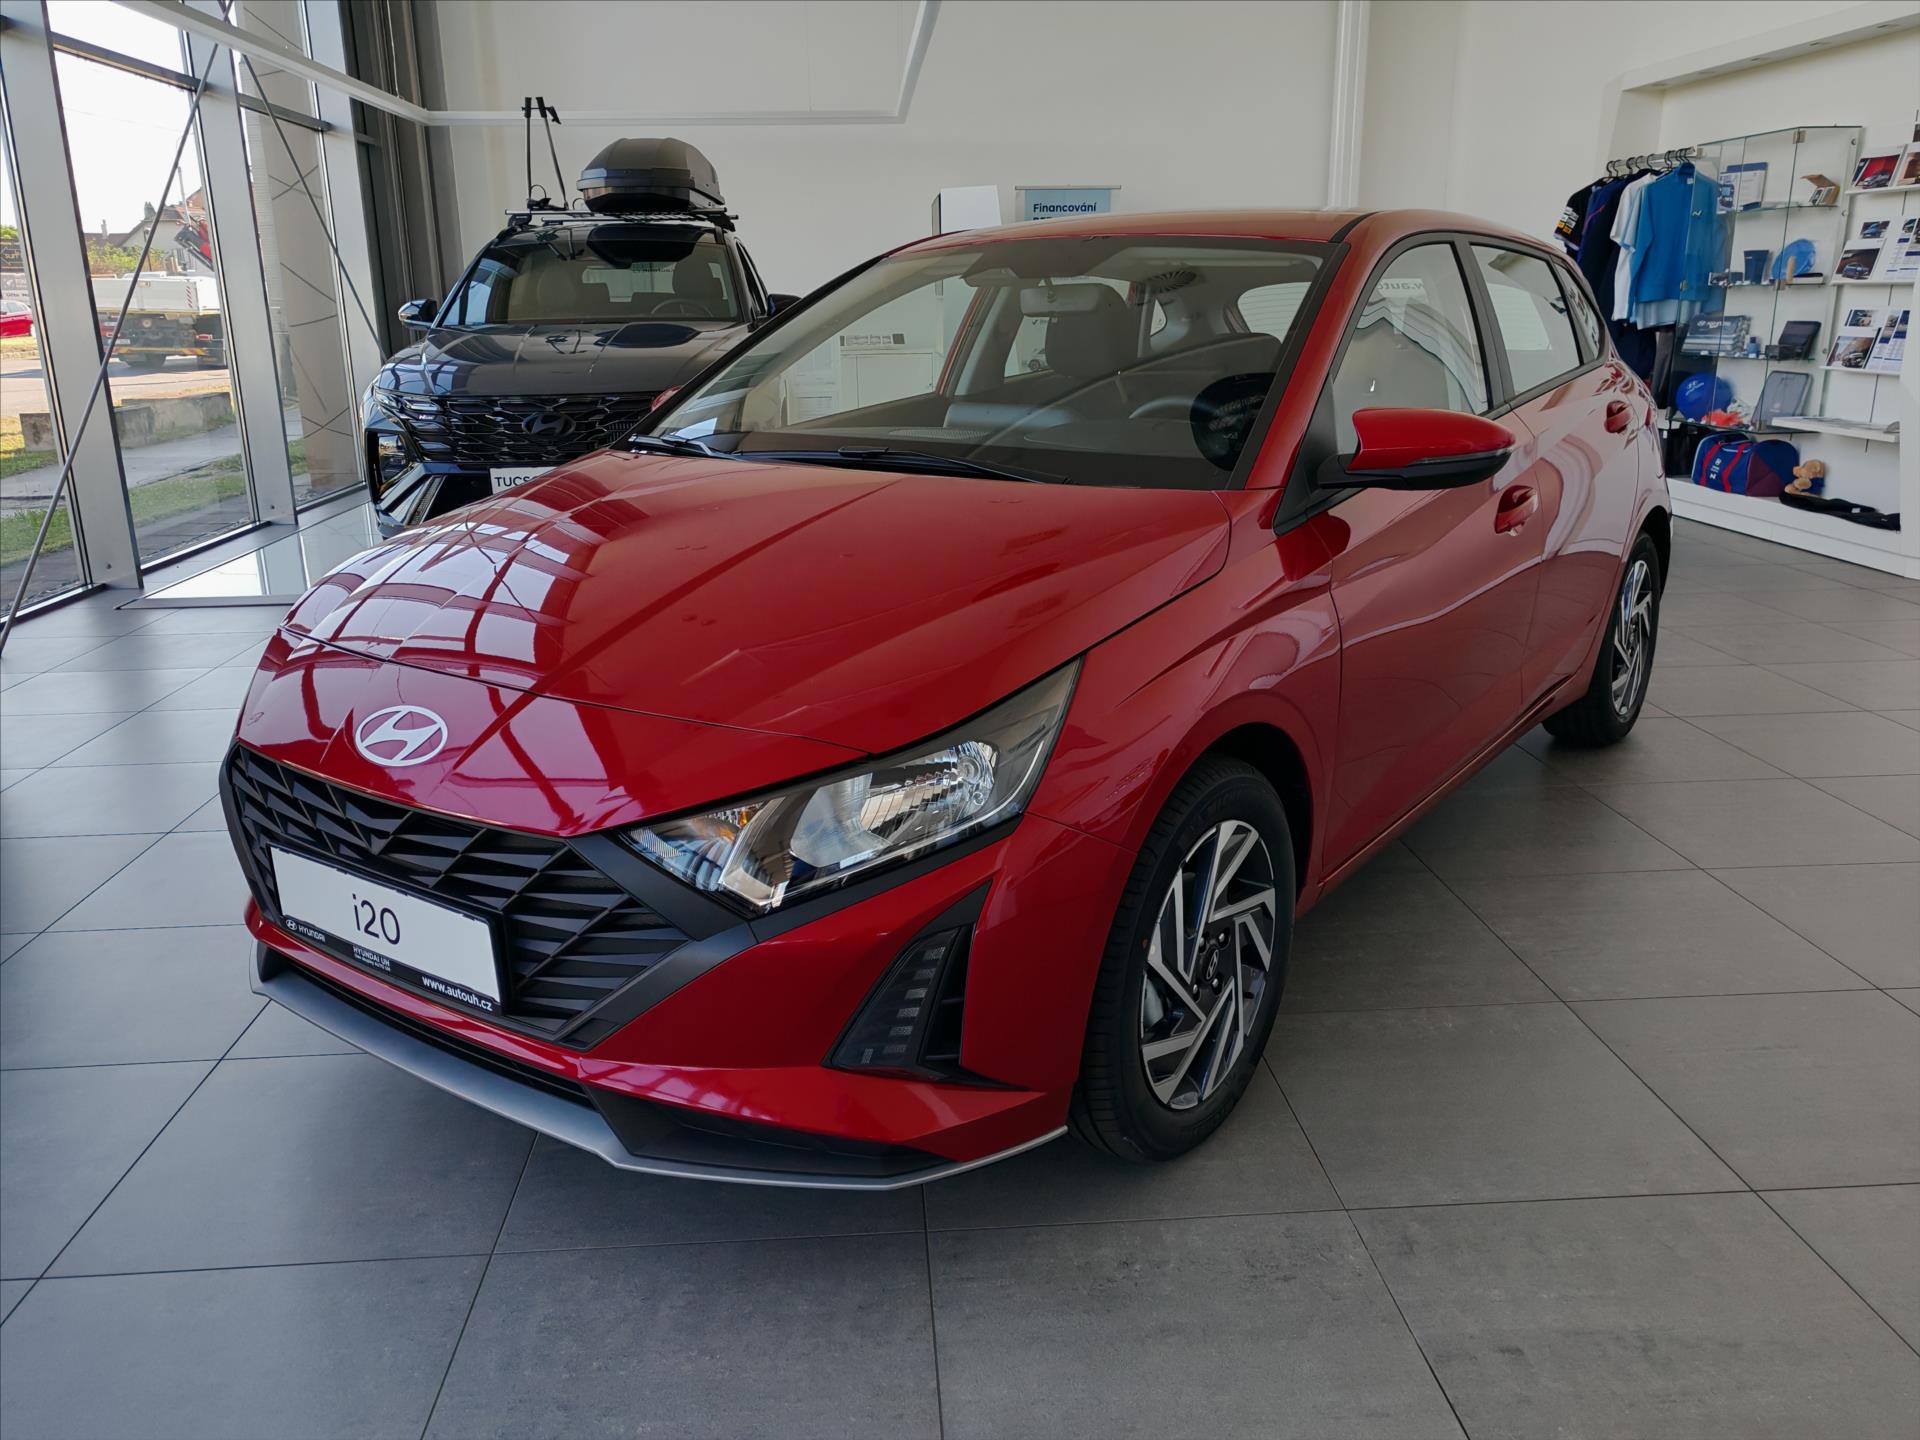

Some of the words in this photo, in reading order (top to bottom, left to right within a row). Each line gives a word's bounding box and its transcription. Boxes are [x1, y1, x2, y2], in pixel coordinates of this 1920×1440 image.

[1033, 202, 1097, 212] Financování
[494, 476, 532, 487] TUCS
[352, 893, 400, 945] i20
[298, 925, 326, 943] HYUNDAI
[353, 946, 380, 963] HYUNDAI
[380, 957, 390, 967] UH
[421, 976, 493, 1011] www.autouh.cz
